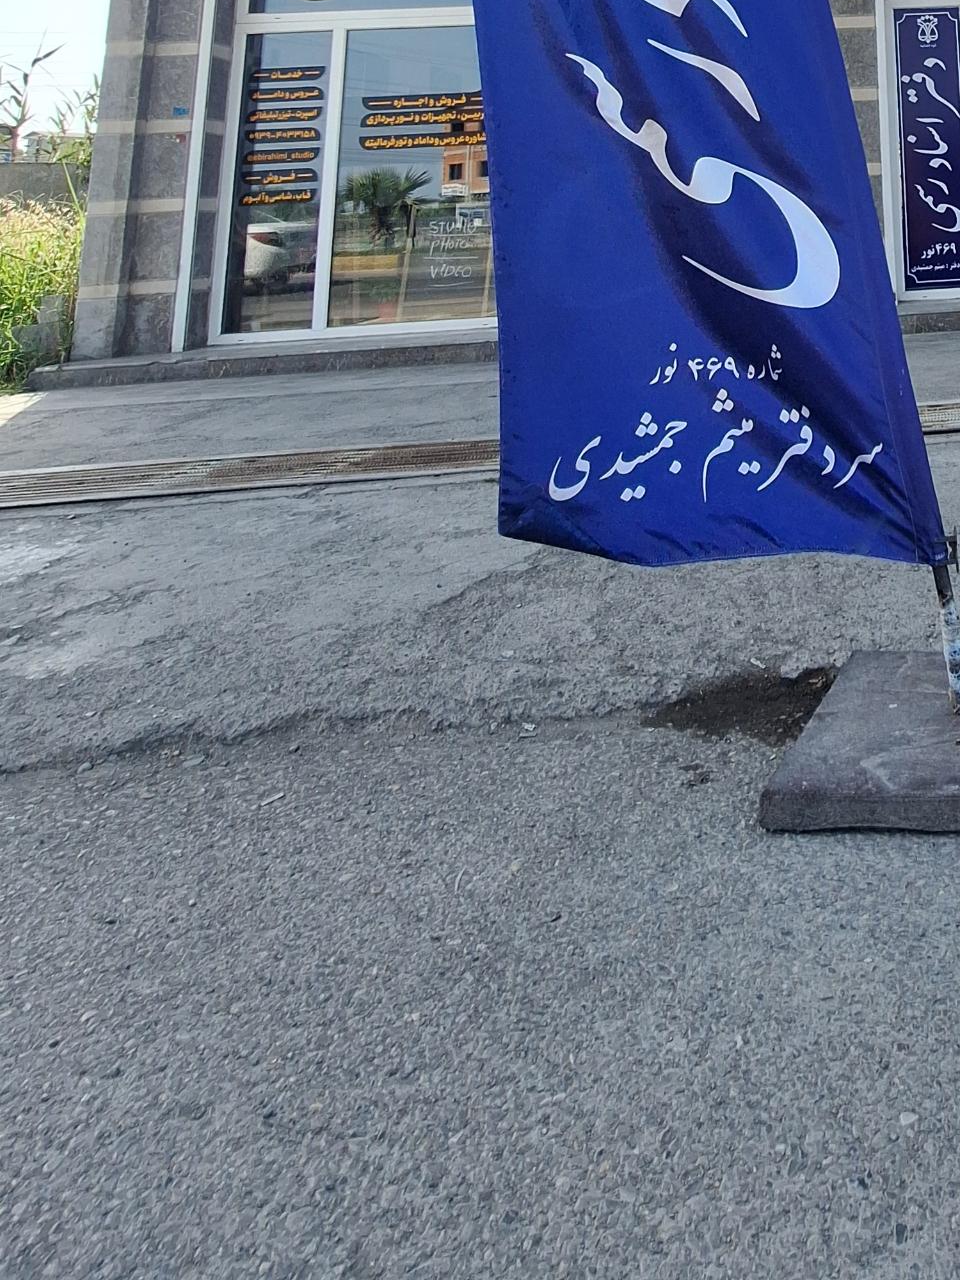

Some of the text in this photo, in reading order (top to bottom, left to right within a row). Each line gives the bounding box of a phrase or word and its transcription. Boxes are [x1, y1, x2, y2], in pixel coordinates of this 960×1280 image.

[270, 69, 303, 79] خدمات
[290, 89, 320, 100] عروس
[435, 94, 467, 107] فروش
[393, 96, 428, 109] اجاره
[421, 111, 457, 123] تجهیزات
[414, 136, 434, 145] داماد
[439, 135, 464, 146] عروس
[464, 132, 487, 144] شاوره
[907, 117, 953, 172] اسناد
[263, 170, 296, 184] فروش
[566, 39, 840, 309] رسمی
[920, 242, 957, 259] ۴۶۹ نور
[430, 264, 472, 279] VIDEO
[649, 342, 783, 385] شماره ۴۶۹ نور
[703, 388, 760, 503] میثم
[548, 411, 688, 502] جمشیدی
